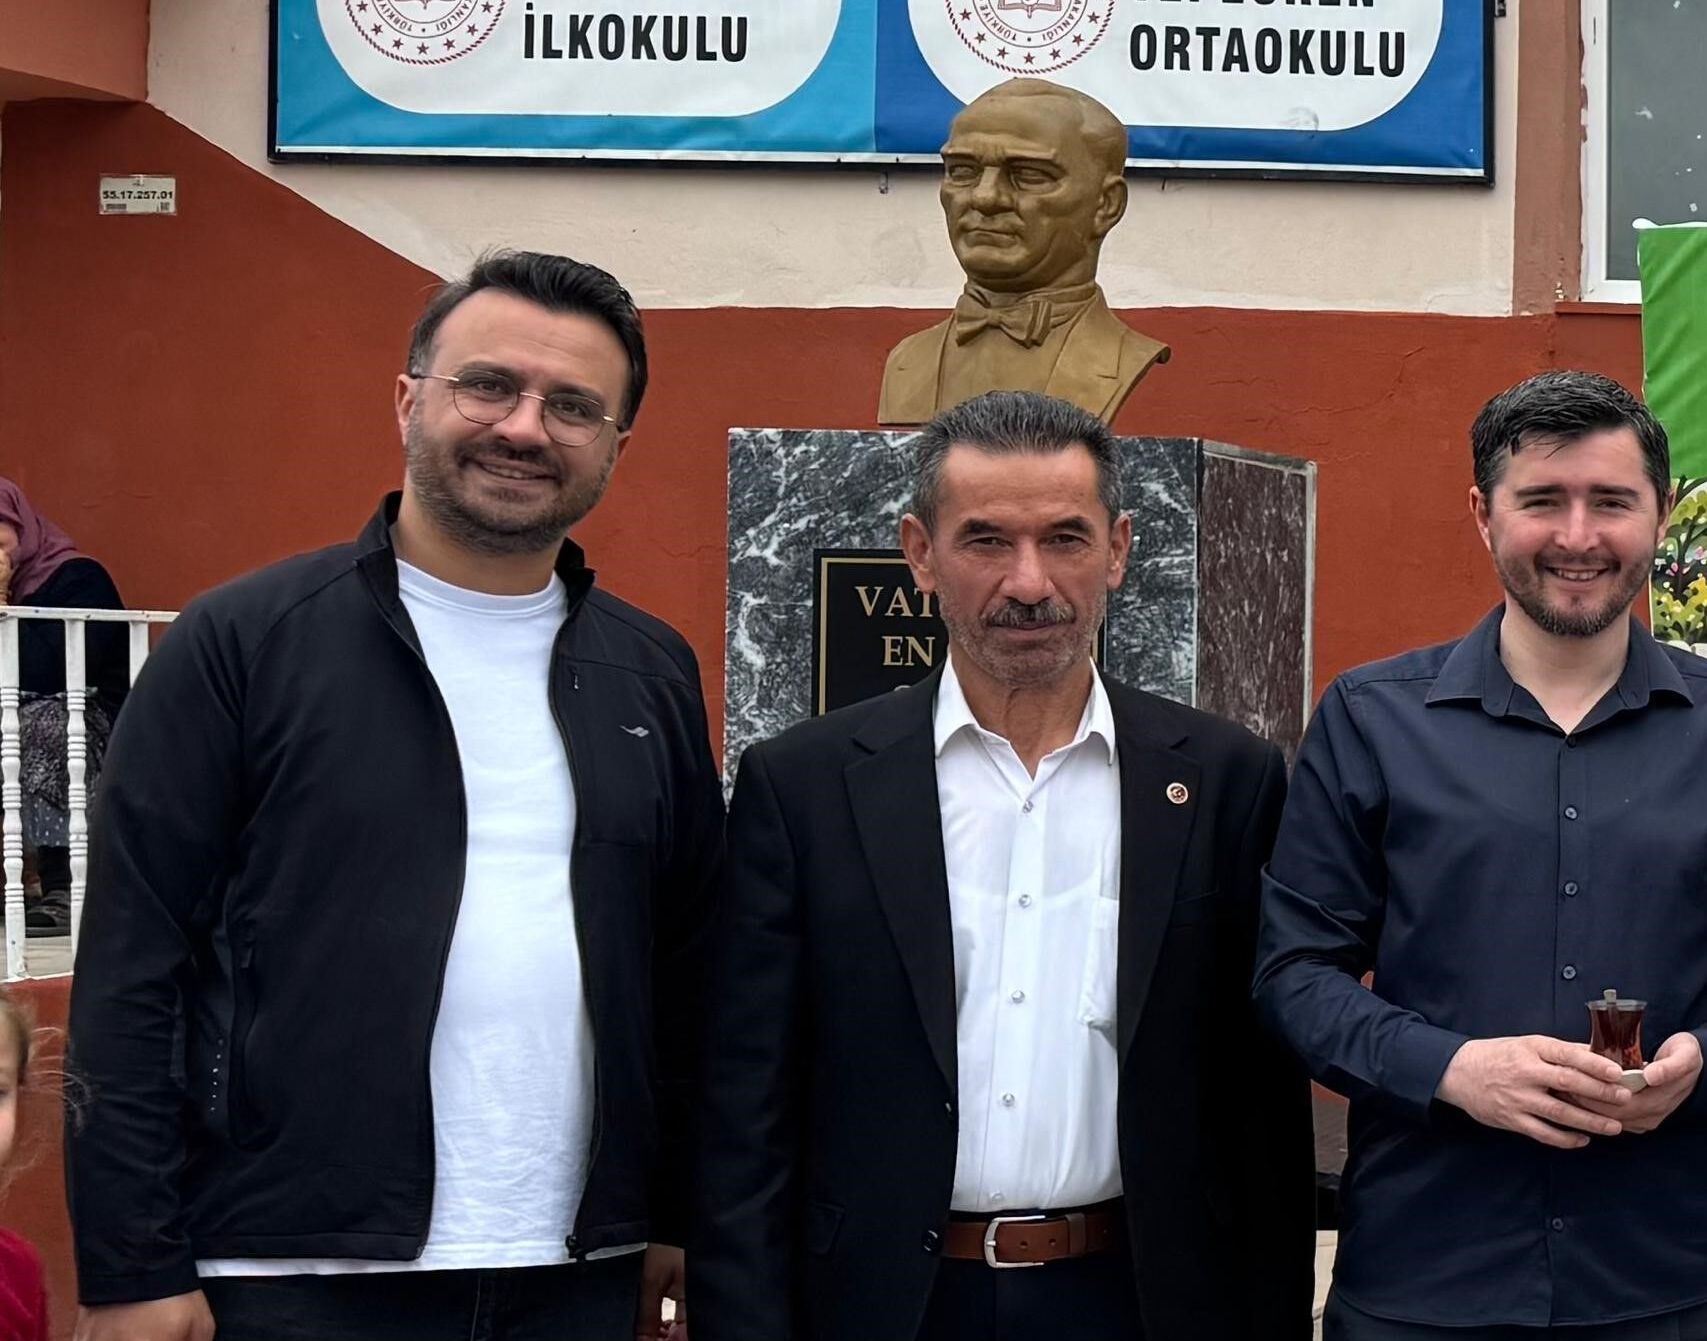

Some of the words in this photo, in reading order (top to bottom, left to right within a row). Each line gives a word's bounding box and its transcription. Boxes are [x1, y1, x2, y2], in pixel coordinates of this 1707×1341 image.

[523, 2, 748, 64] İLKOKULU
[1129, 23, 1406, 78] ORTAOKULU
[102, 190, 173, 200] 55.17.257.01
[881, 635, 936, 667] EN
